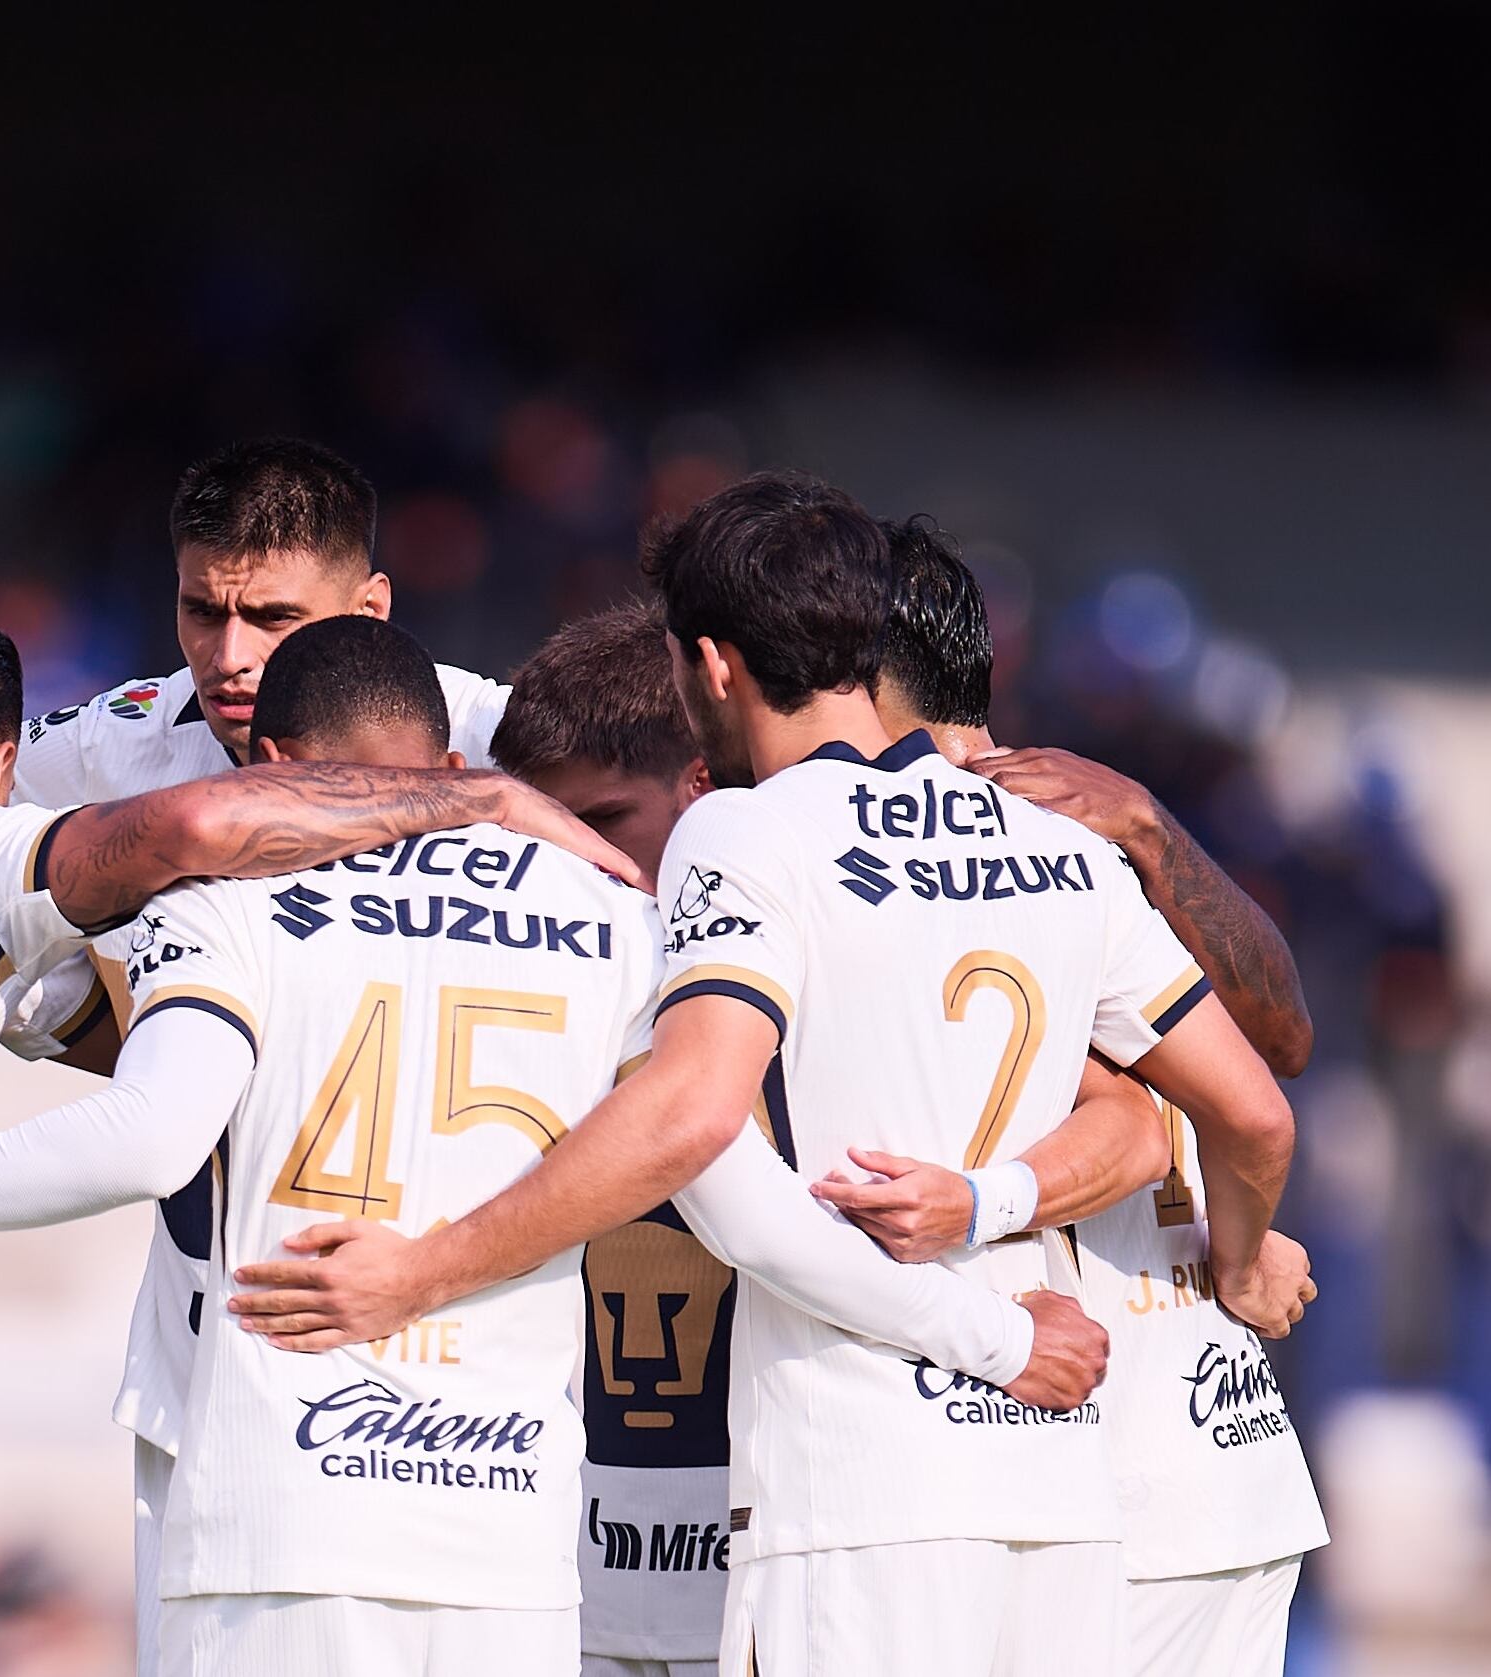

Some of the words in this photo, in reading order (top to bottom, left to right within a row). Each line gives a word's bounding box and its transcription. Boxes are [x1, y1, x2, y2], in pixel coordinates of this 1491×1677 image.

[904, 853, 1096, 901] SUZUKI
[350, 893, 612, 960] SUZUKI
[942, 949, 1047, 1170] 2
[268, 981, 571, 1222] 45
[1127, 1270, 1167, 1315] J.
[295, 1378, 544, 1455] Caliente
[321, 1449, 538, 1494] caliente.mx
